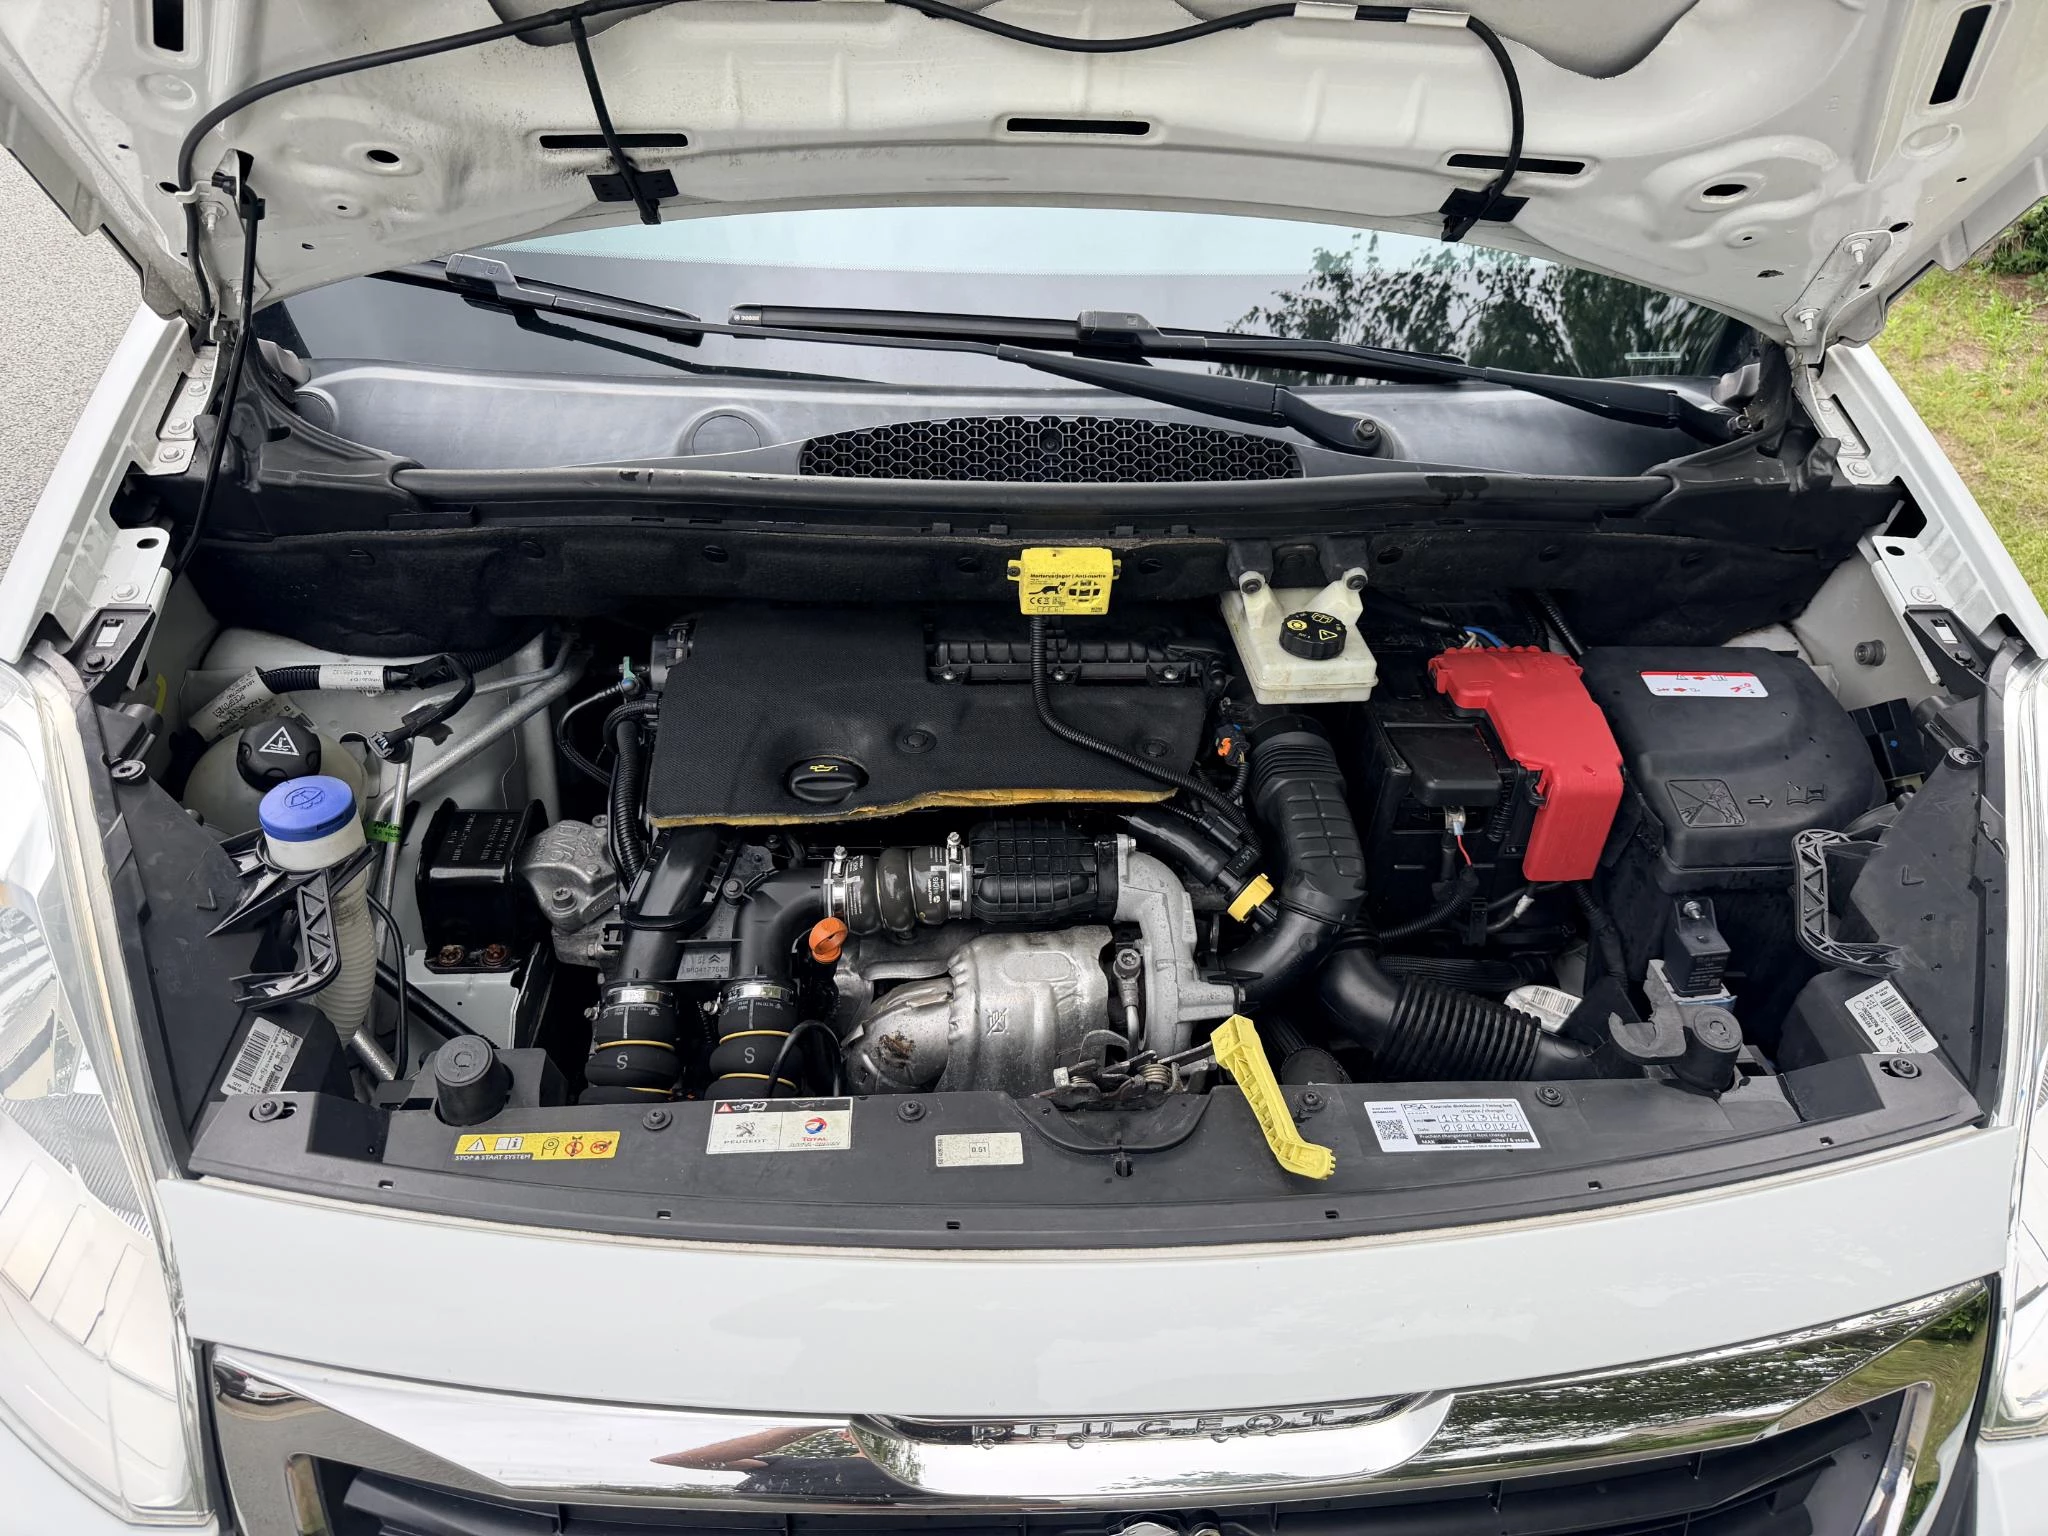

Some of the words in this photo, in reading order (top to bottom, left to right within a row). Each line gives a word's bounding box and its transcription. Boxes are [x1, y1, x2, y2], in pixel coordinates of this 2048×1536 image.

[616, 1054, 629, 1070] S
[744, 1047, 755, 1063] S
[972, 1410, 1334, 1442] PEUGEOT
